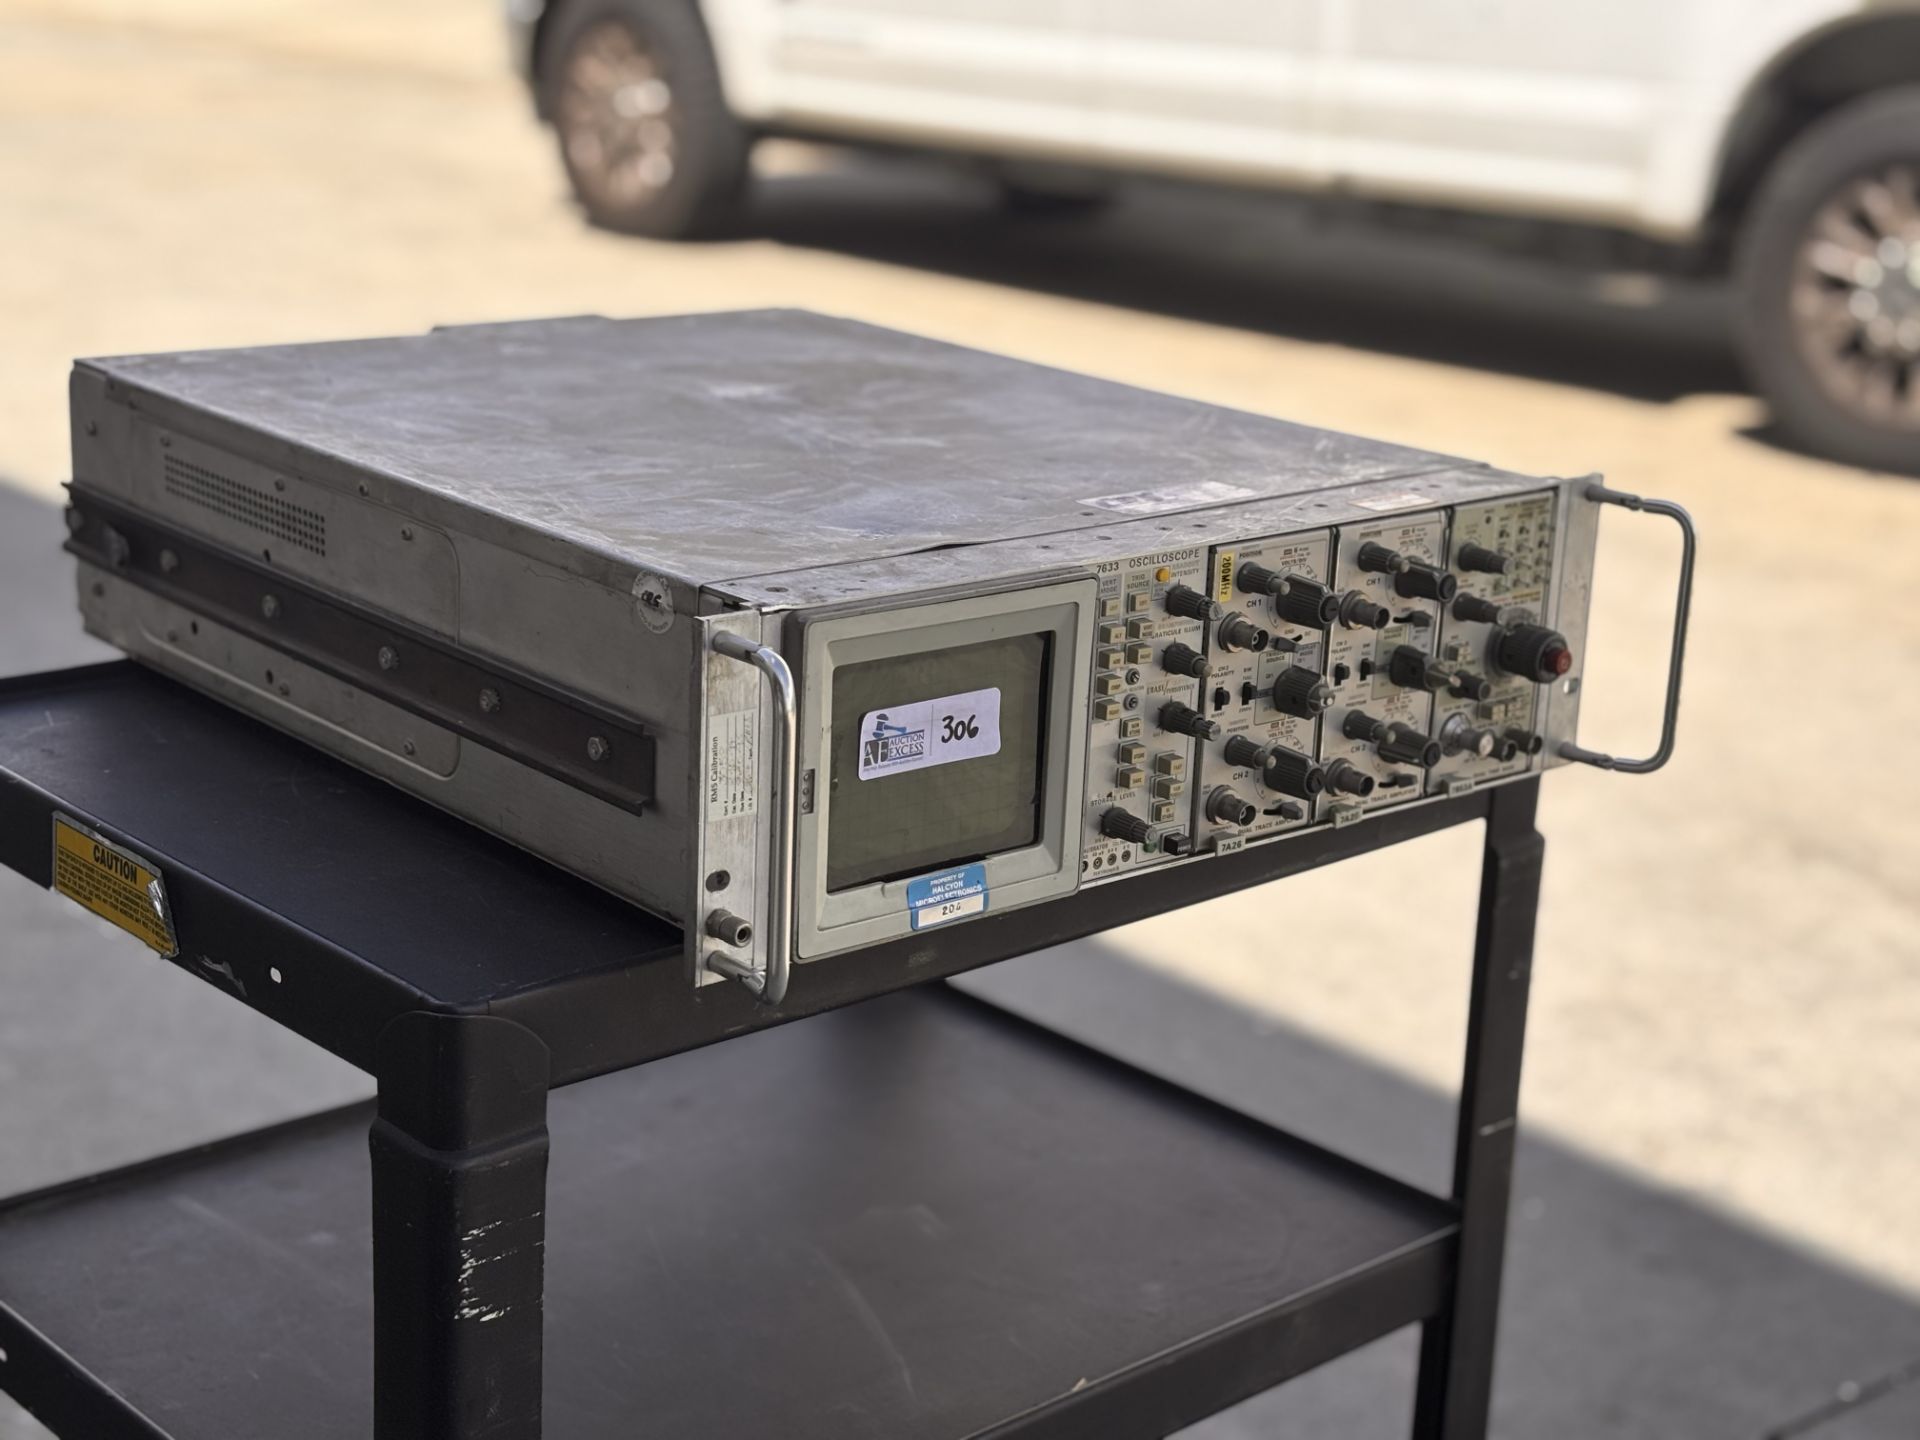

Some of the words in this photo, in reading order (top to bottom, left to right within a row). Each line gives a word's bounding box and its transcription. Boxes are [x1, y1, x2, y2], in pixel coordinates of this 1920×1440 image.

[1096, 562, 1119, 574] 7633
[1129, 549, 1200, 568] OSCILLOSCOPE
[1220, 556, 1232, 596] 200MHz
[1366, 578, 1377, 586] CH
[1102, 578, 1117, 587] VERT
[1127, 580, 1149, 589] SOURCE
[1246, 601, 1257, 609] CH
[1211, 671, 1235, 679] POLARITY
[941, 714, 979, 744] 306
[1227, 725, 1249, 734] POSITION
[889, 733, 925, 745] AUCTION
[888, 743, 924, 757] EXCESS
[1233, 771, 1244, 781] CH
[1244, 770, 1249, 778] 2
[1091, 796, 1117, 807] STORAGE
[1119, 792, 1136, 800] LEVEL
[1255, 822, 1272, 831] TRACE
[1221, 840, 1242, 852] 7A26
[93, 845, 137, 884] CAUTION
[930, 874, 957, 886] PROPERTY
[932, 880, 964, 895] HALCYON
[915, 884, 983, 907] MICROELECTRONICS
